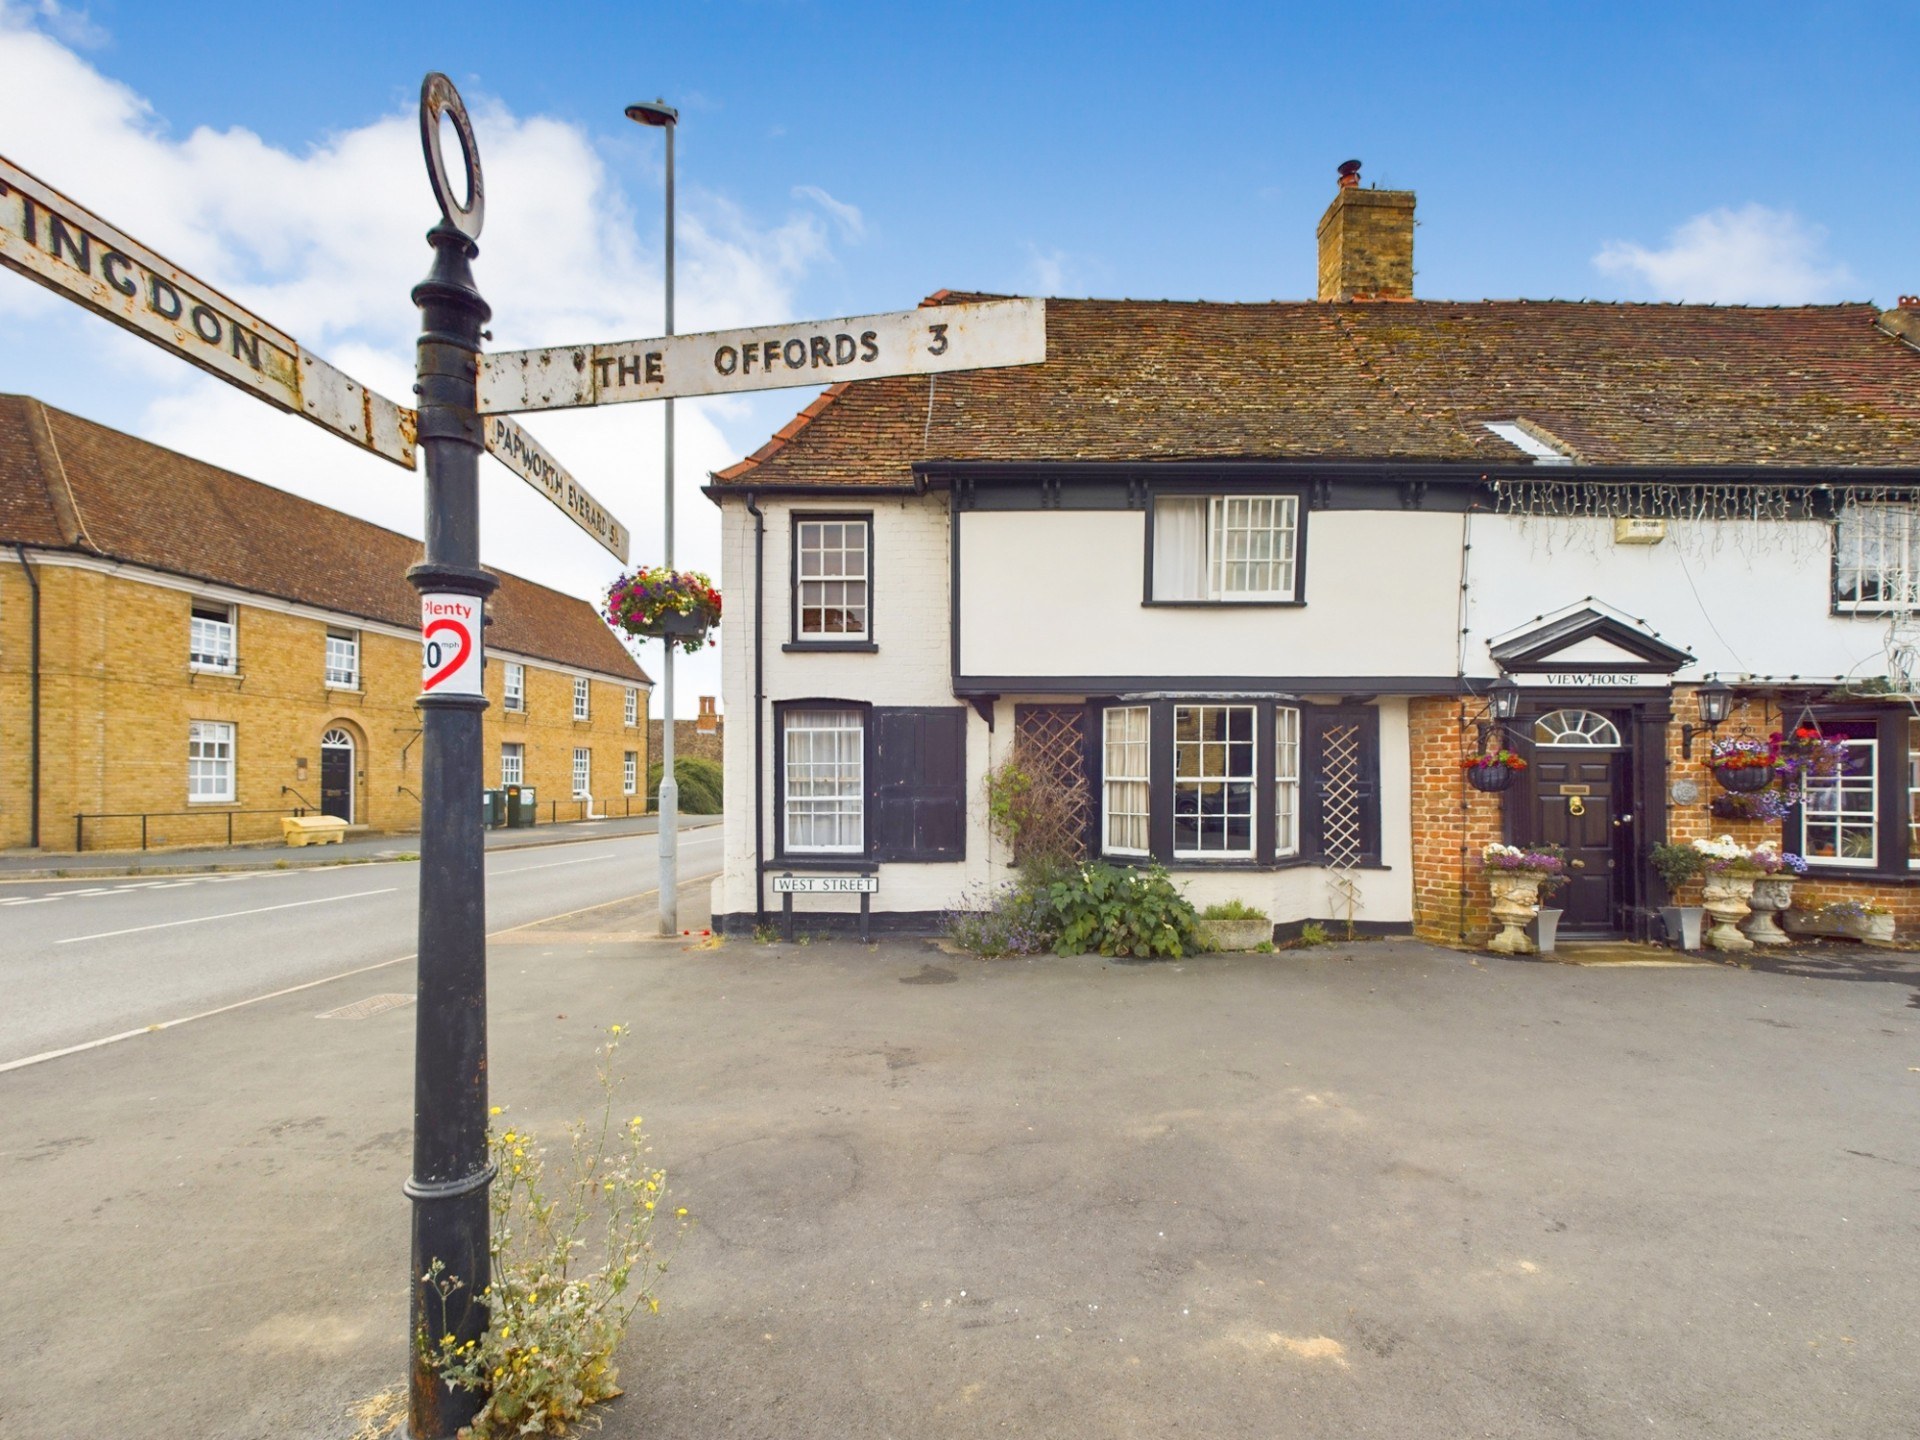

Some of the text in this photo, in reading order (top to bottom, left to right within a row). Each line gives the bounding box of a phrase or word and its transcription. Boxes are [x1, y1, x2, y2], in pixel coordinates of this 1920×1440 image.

[0, 183, 263, 372] INGDON
[592, 323, 949, 388] THE OFFORDS 3
[495, 418, 564, 498] PAPWORTH
[567, 484, 608, 536] EVERARD
[422, 641, 460, 668] 0 mph
[1546, 674, 1639, 685] VIEW HOUSE
[779, 879, 873, 890] WEST STREET
